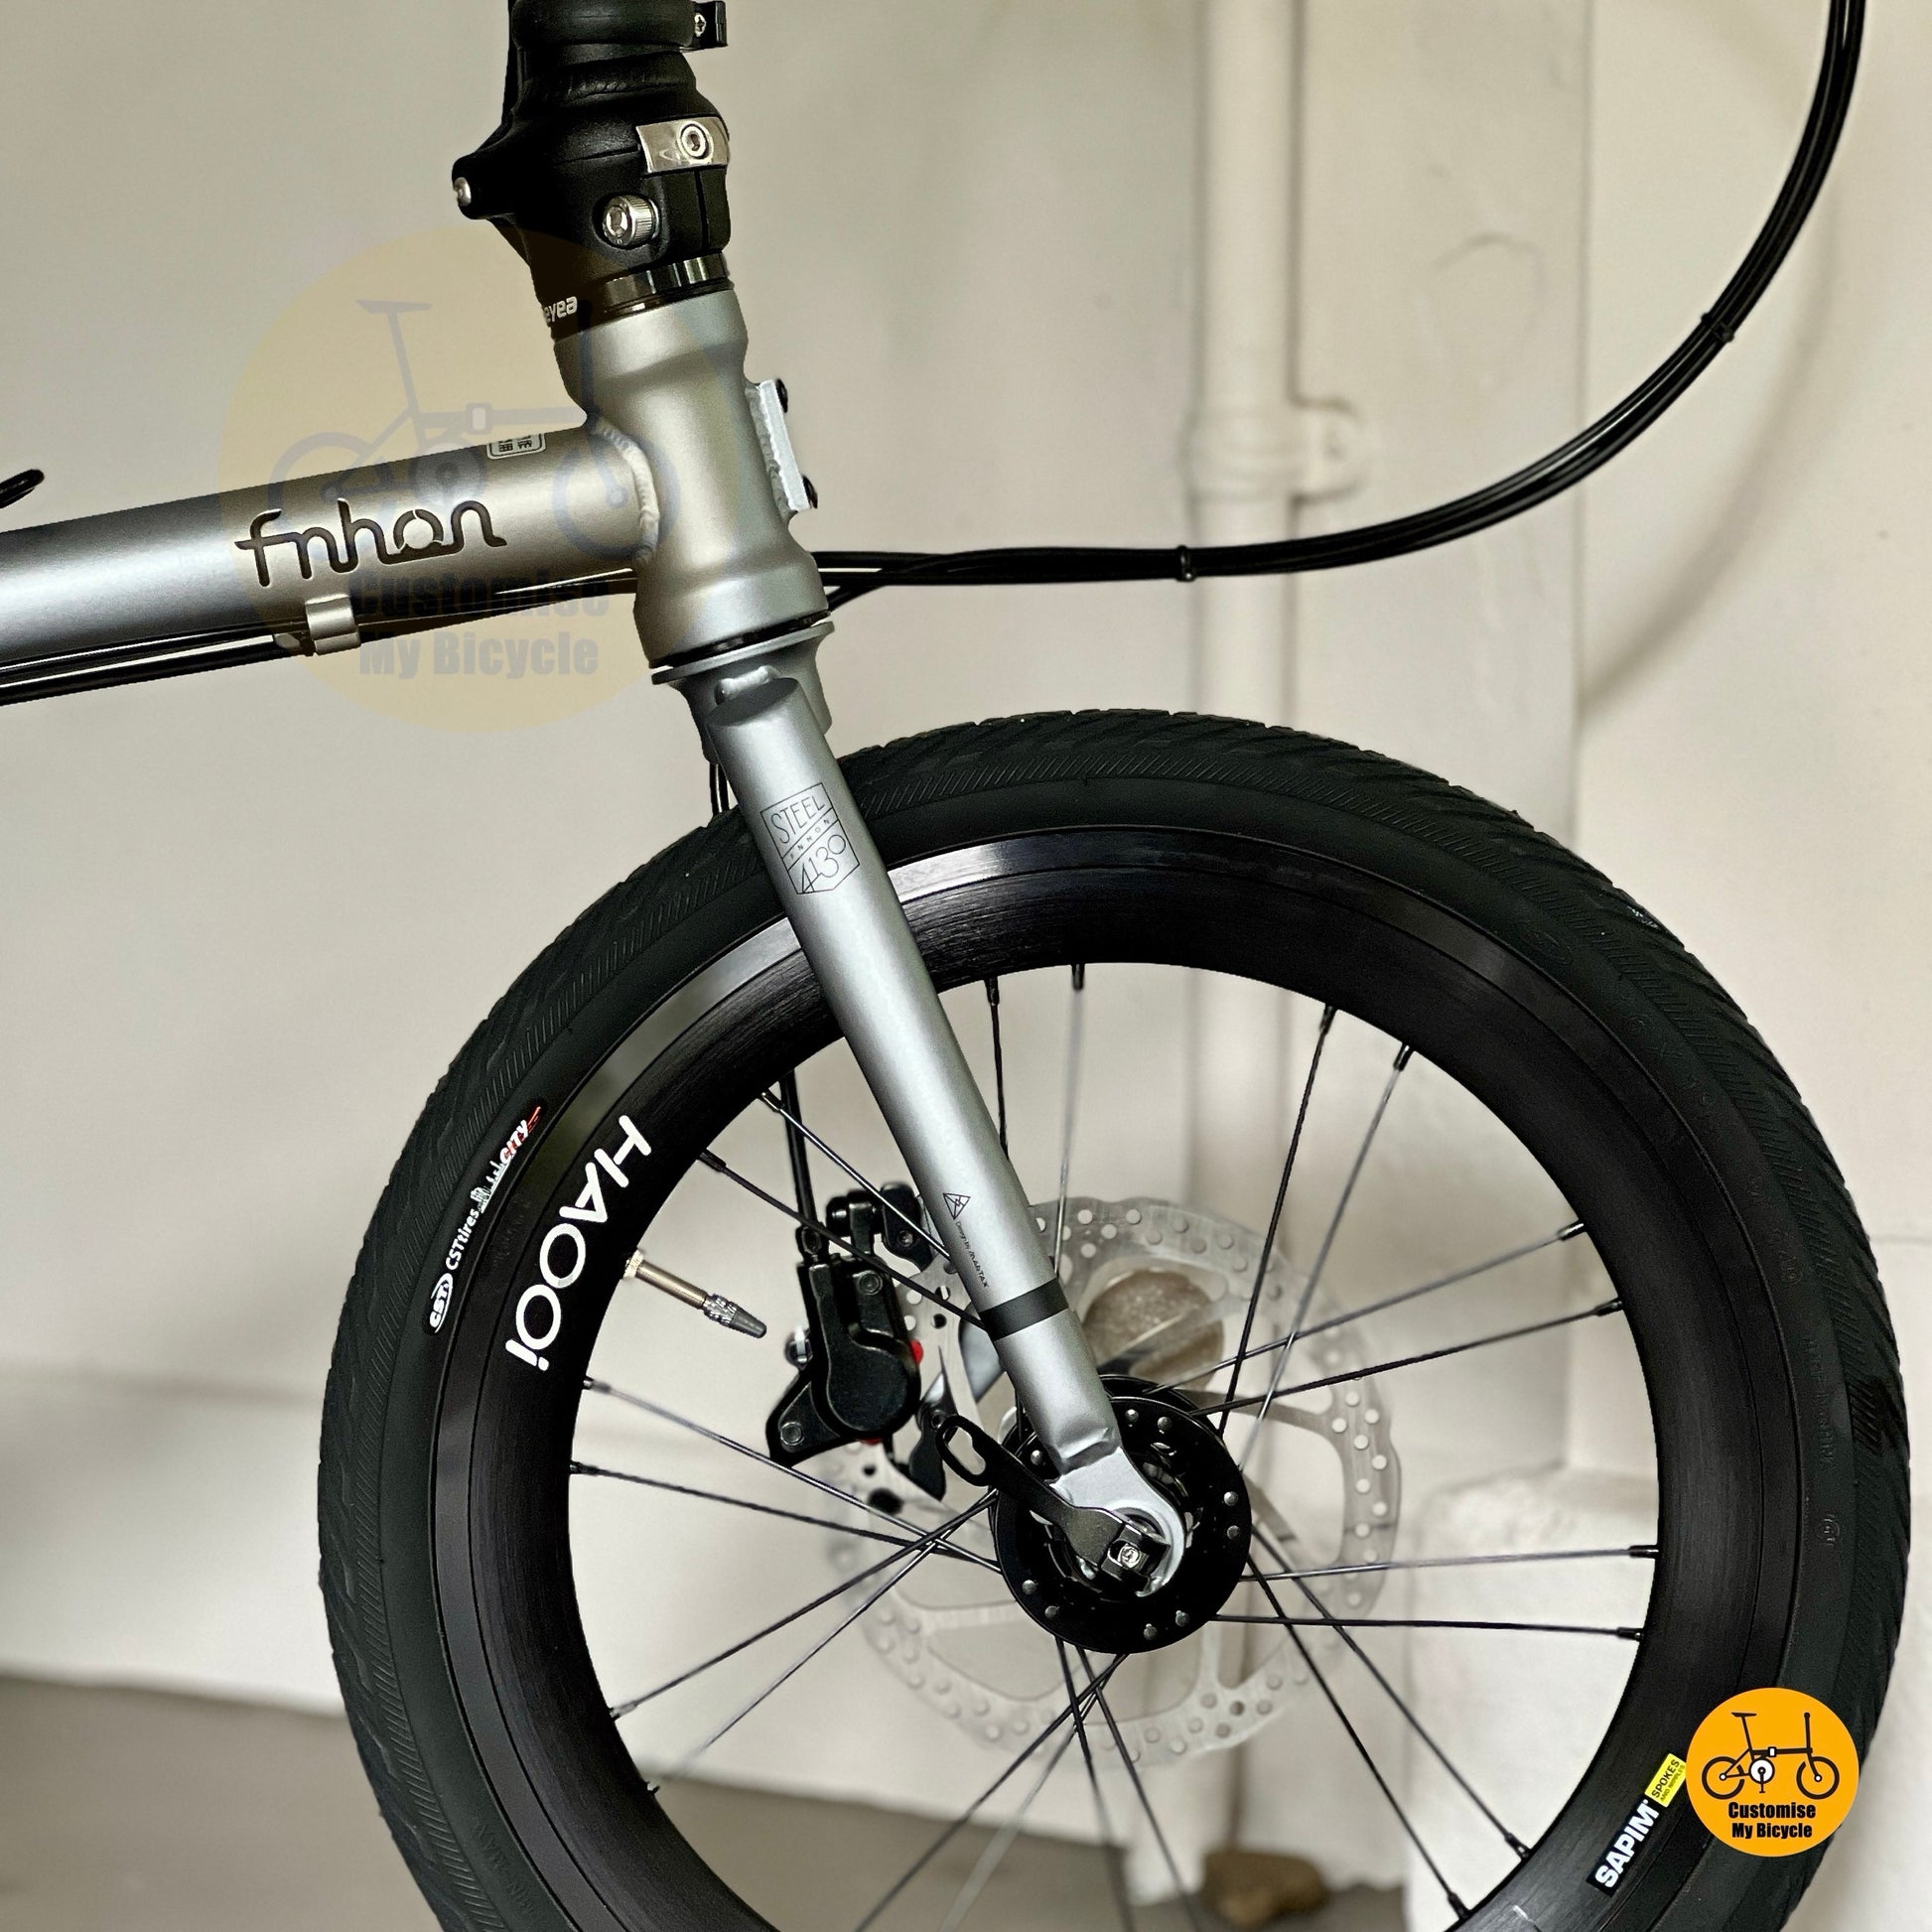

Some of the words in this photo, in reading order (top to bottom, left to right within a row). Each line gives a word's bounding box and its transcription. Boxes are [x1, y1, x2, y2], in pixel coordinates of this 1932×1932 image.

[770, 794, 826, 844] STEEL
[801, 834, 846, 894] 4130
[446, 1208, 480, 1271] CSTtires
[499, 1120, 529, 1165] CITY
[1651, 1759, 1680, 1798] SPOKES
[1594, 1800, 1660, 1888] SAPIM
